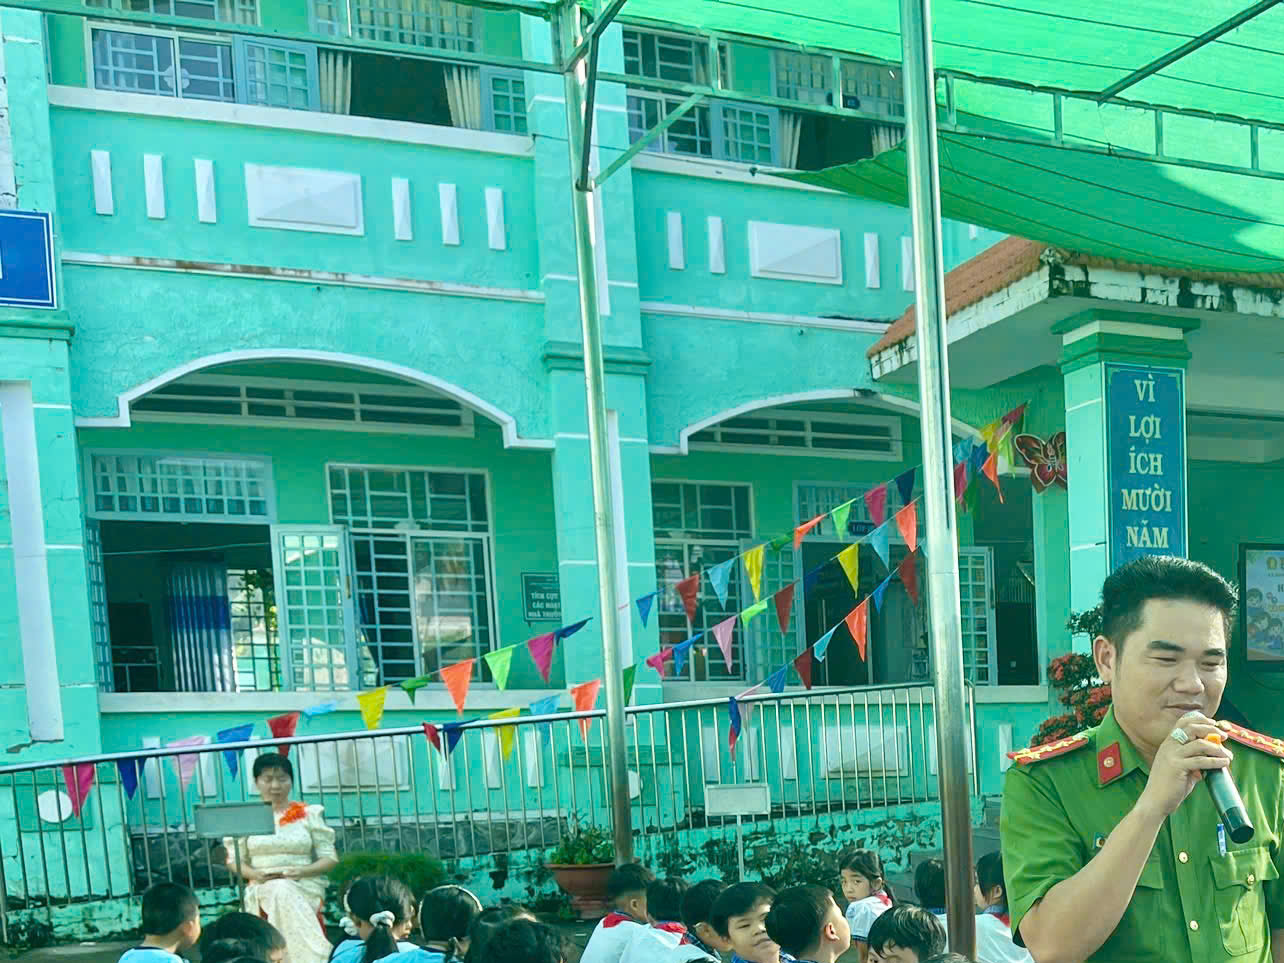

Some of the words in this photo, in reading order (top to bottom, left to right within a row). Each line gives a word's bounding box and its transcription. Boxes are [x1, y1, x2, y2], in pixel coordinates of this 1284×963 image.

[1134, 373, 1156, 403] VÌ
[1128, 413, 1162, 445] LỢI
[1128, 445, 1164, 475] ÍCH
[1121, 483, 1172, 512] MƯỜI
[1126, 519, 1169, 549] NĂM
